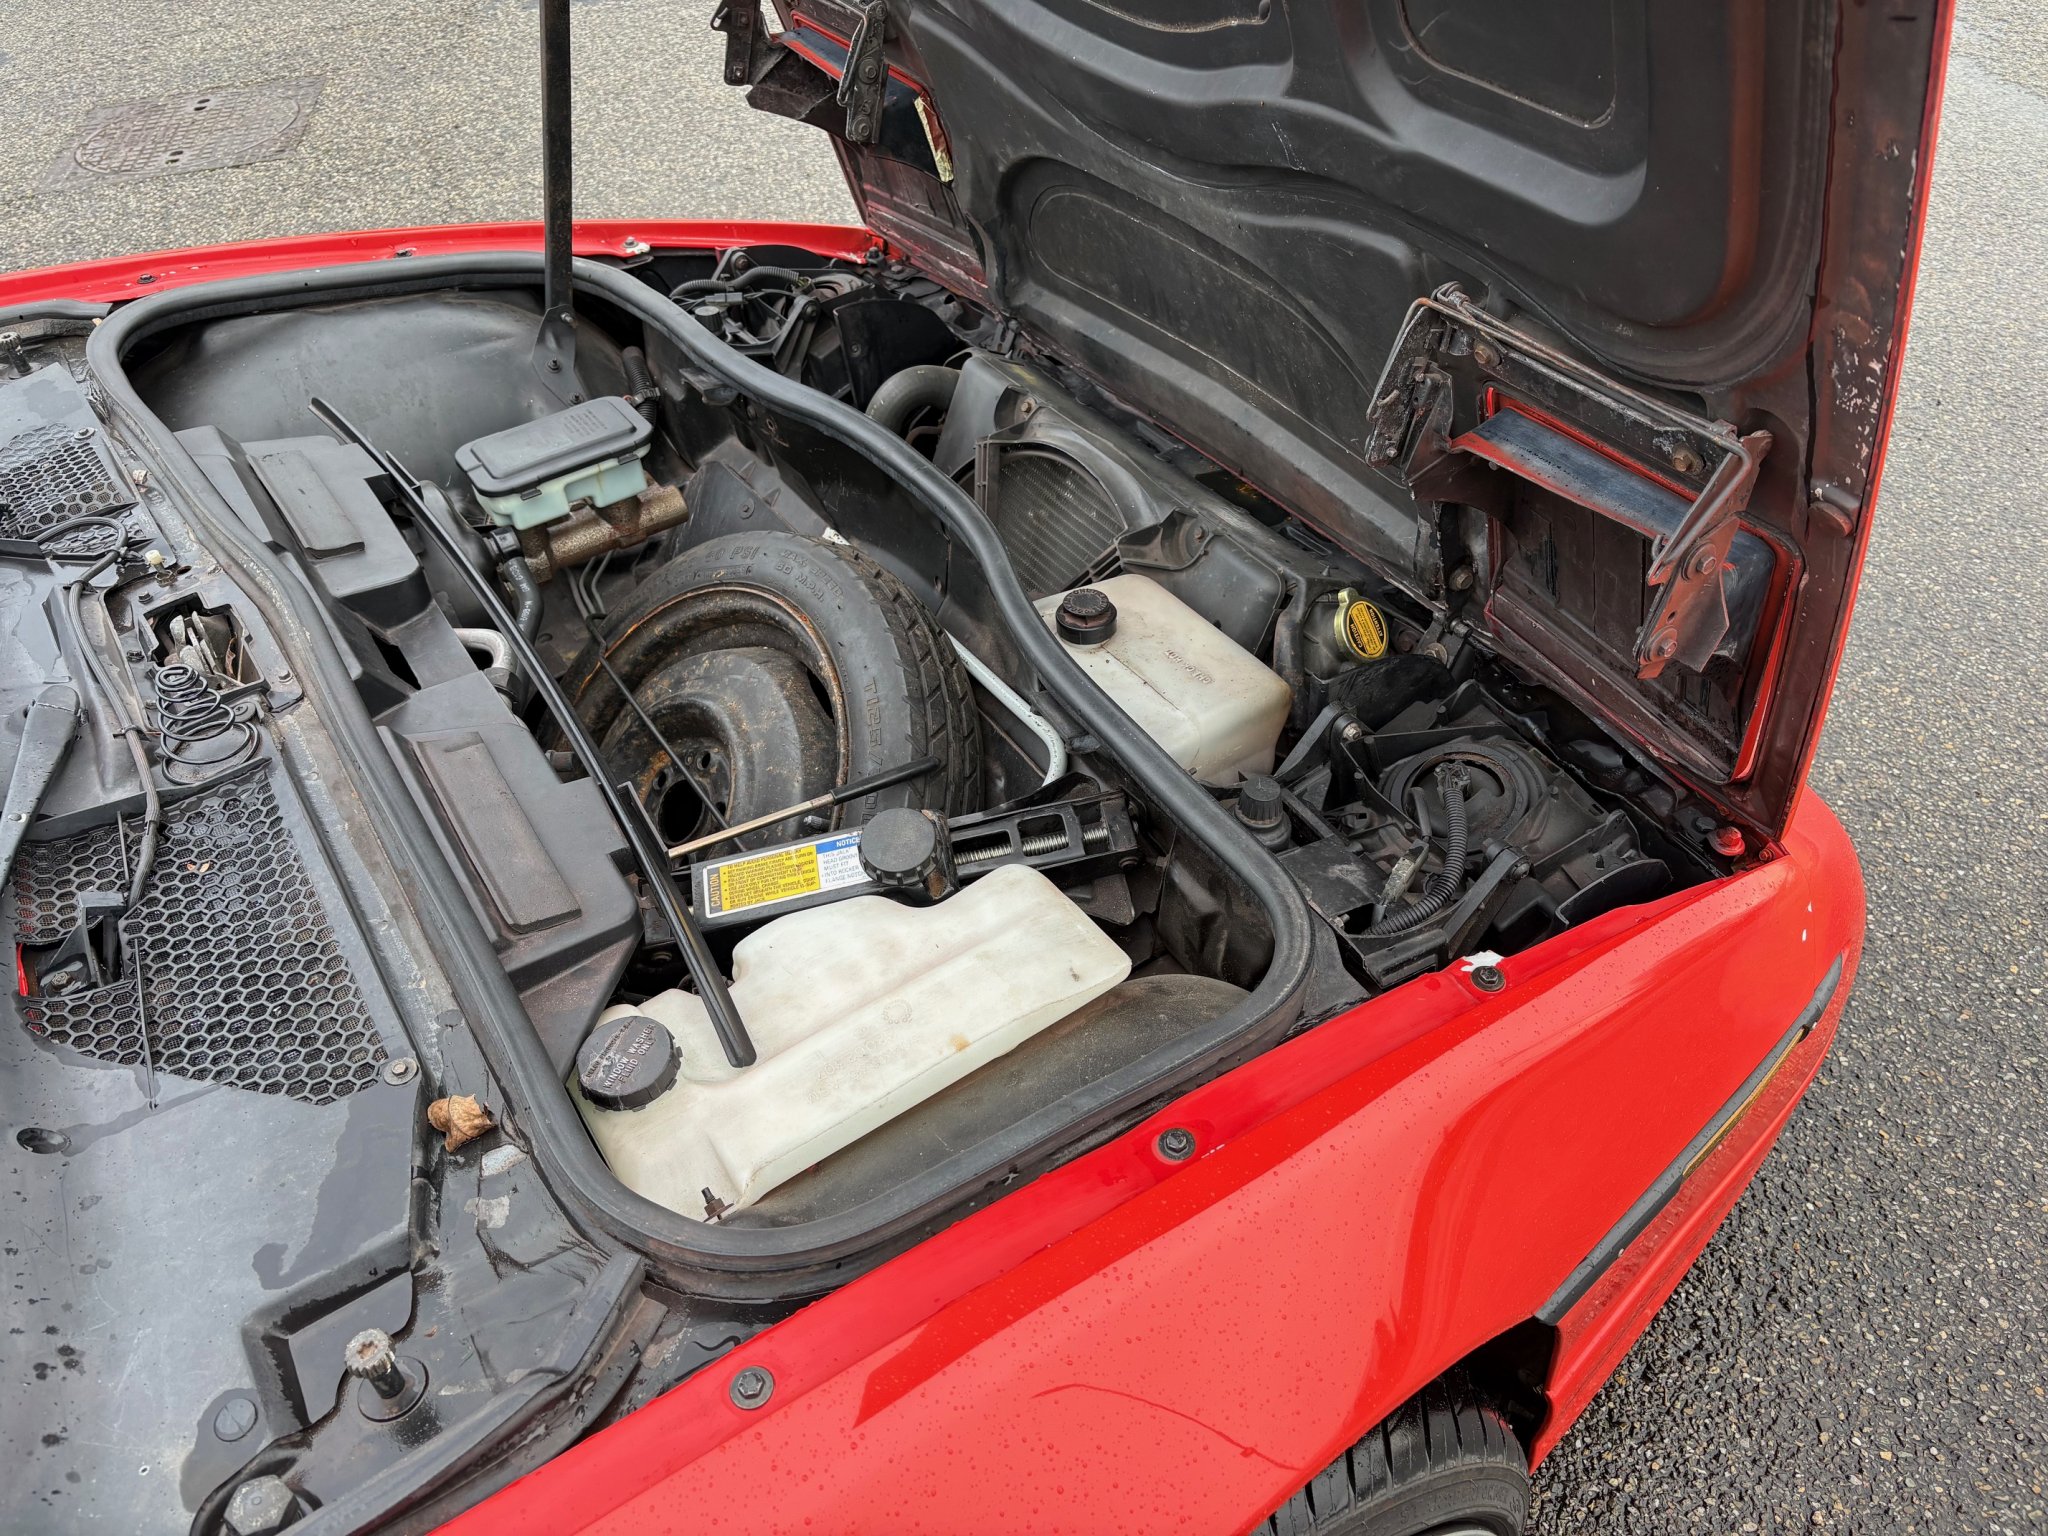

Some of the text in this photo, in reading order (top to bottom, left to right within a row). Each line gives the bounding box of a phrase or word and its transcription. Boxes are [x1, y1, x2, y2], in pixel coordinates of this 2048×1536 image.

[730, 546, 760, 560] PSI
[1350, 624, 1362, 648] CAUTION
[1369, 608, 1383, 637] ATTENTION
[825, 863, 838, 871] MUST
[711, 873, 719, 906] CAUTION
[603, 1024, 656, 1089] WINDOW WASHER
[618, 1037, 657, 1084] FLUID ONLY
